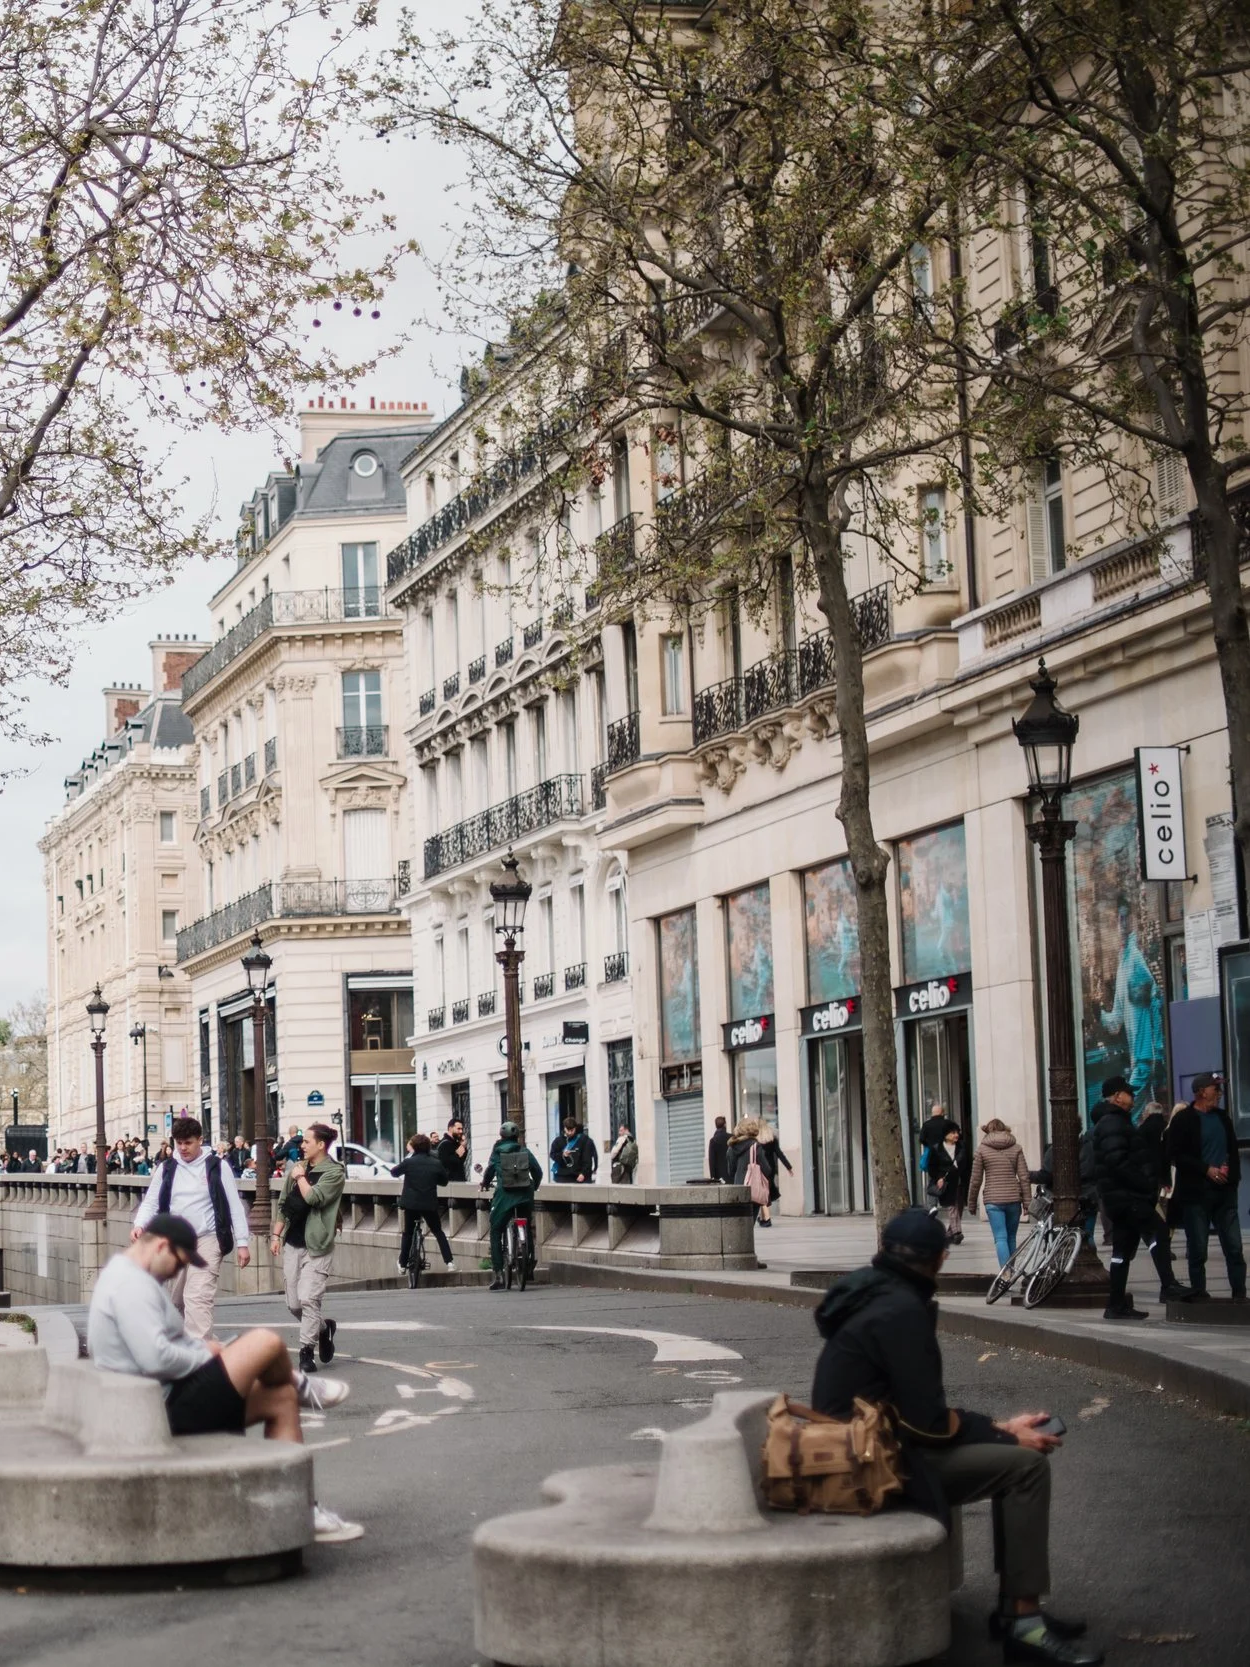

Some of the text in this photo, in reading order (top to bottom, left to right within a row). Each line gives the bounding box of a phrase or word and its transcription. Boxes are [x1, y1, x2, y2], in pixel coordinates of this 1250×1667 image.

[1150, 780, 1174, 864] celio
[909, 981, 949, 1013] celio
[812, 1002, 849, 1031] celio
[731, 1020, 763, 1046] celio
